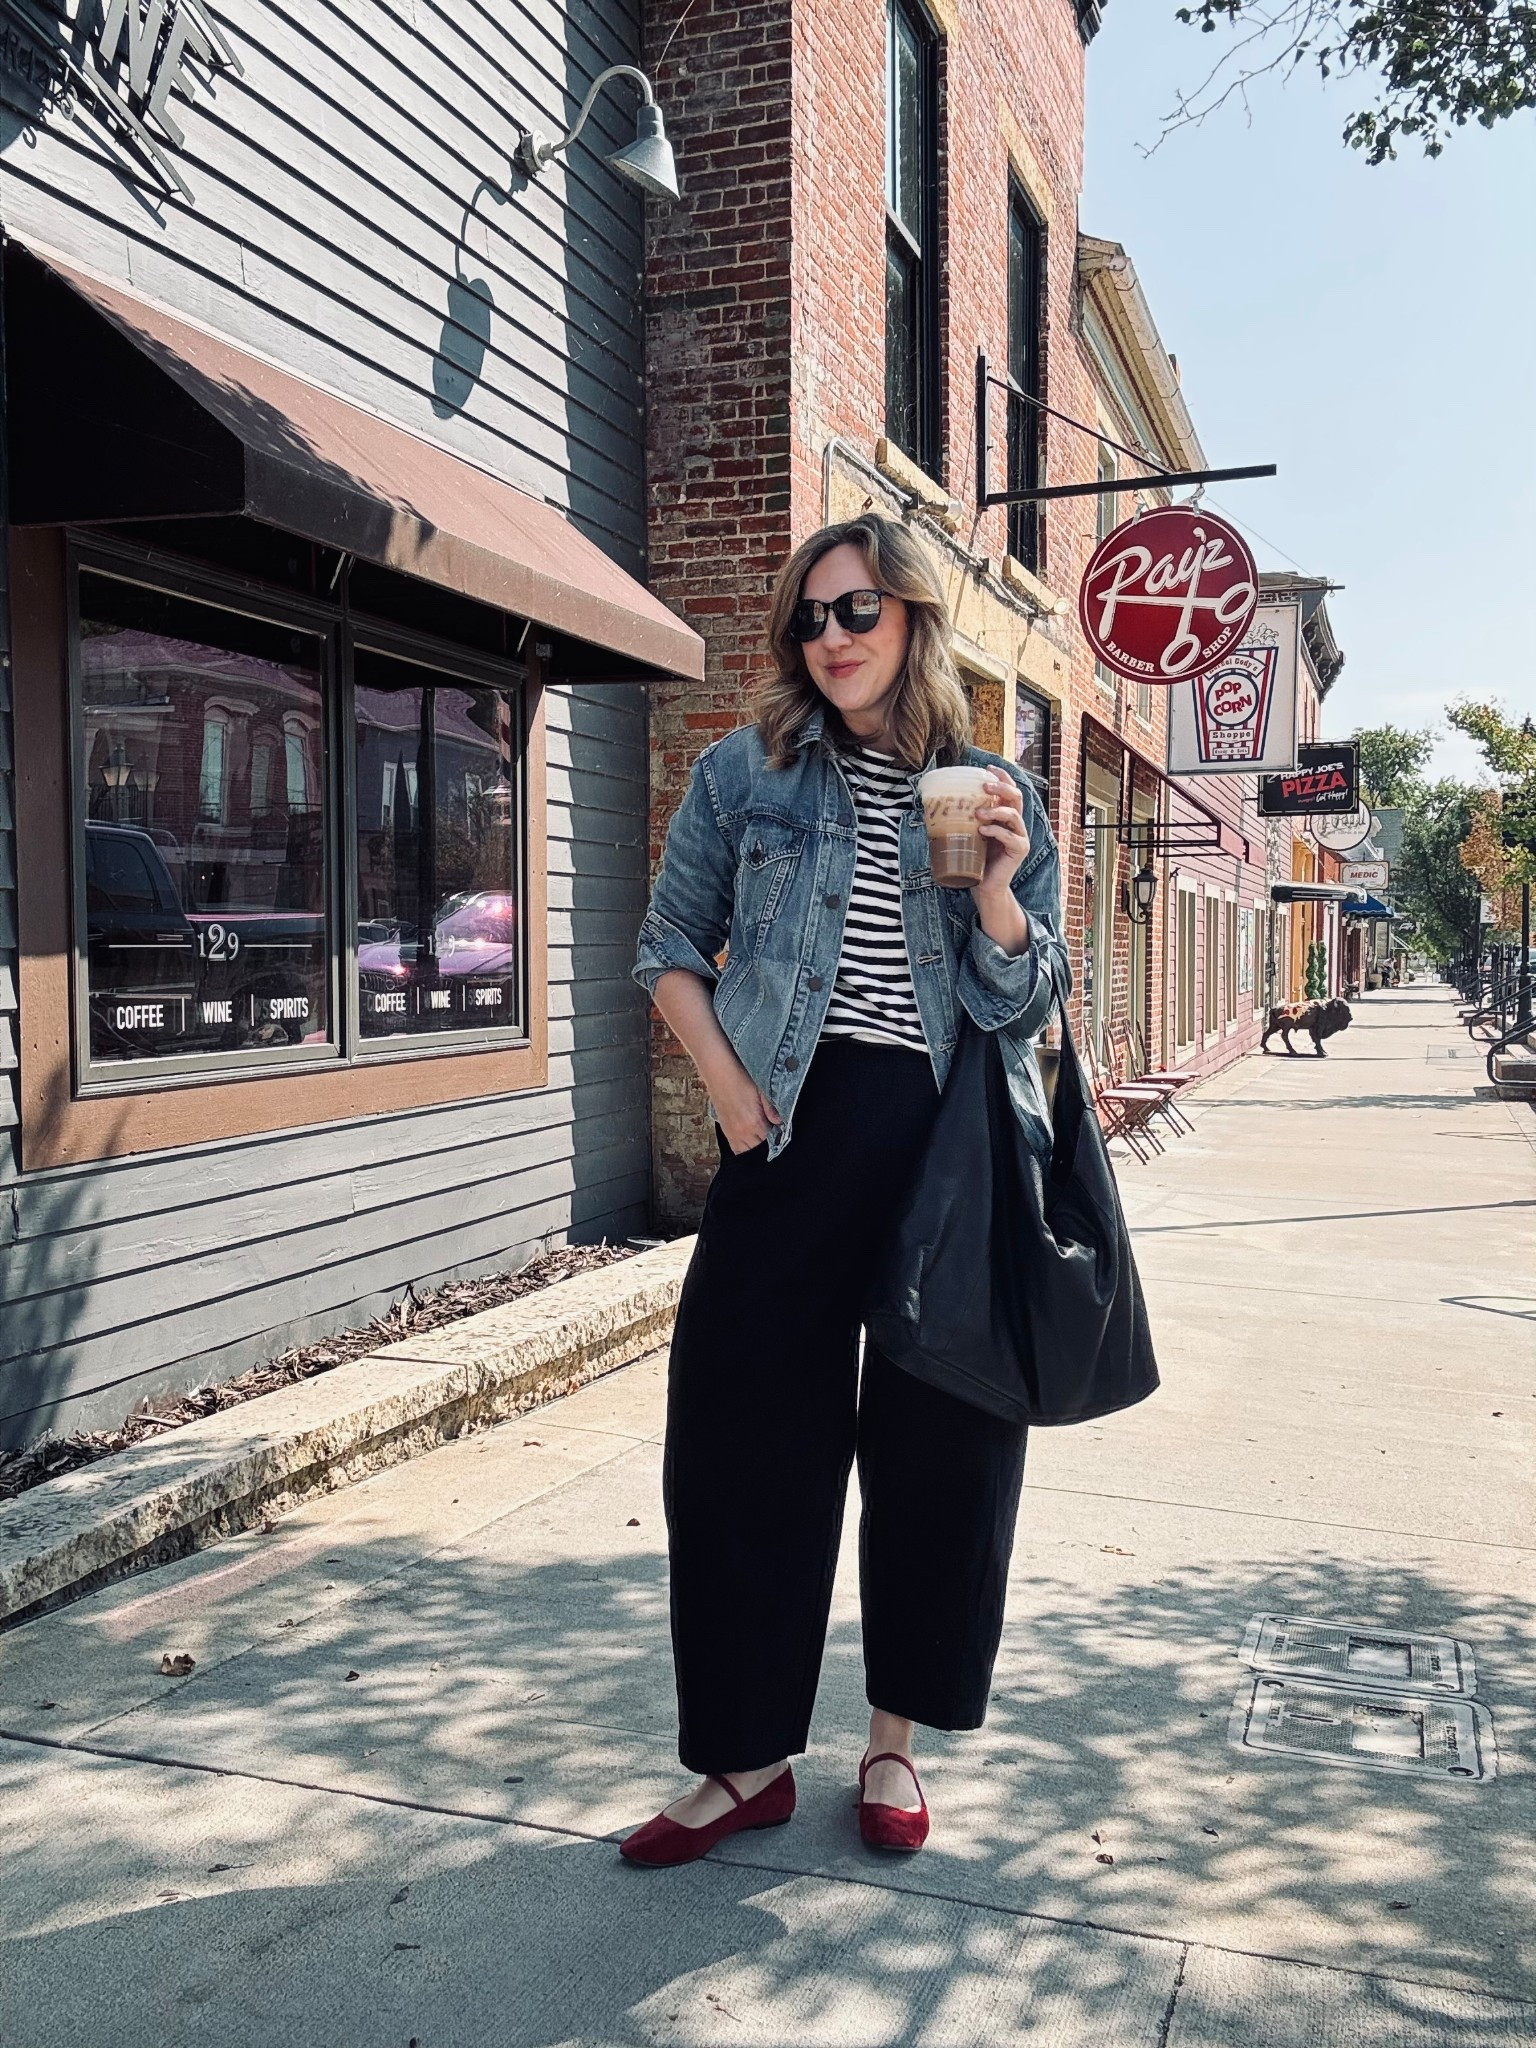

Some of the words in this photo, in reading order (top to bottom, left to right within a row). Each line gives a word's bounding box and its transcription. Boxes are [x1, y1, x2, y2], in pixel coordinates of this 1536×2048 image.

[1105, 640, 1155, 673] BARBER
[1201, 625, 1233, 659] SHOP
[1214, 681, 1242, 701] POP
[1213, 694, 1253, 717] CORN
[1212, 731, 1251, 739] Shoppe
[1281, 771, 1348, 798] PIZZA
[1350, 871, 1379, 879] MEDIC
[198, 923, 240, 962] 129
[374, 992, 407, 1013] COFFEE
[430, 989, 452, 1009] WINE
[475, 987, 503, 1006] SPIRITS
[116, 1004, 165, 1030] COFFEE
[202, 1000, 233, 1024] WINE
[269, 997, 309, 1020] SPIRITS
